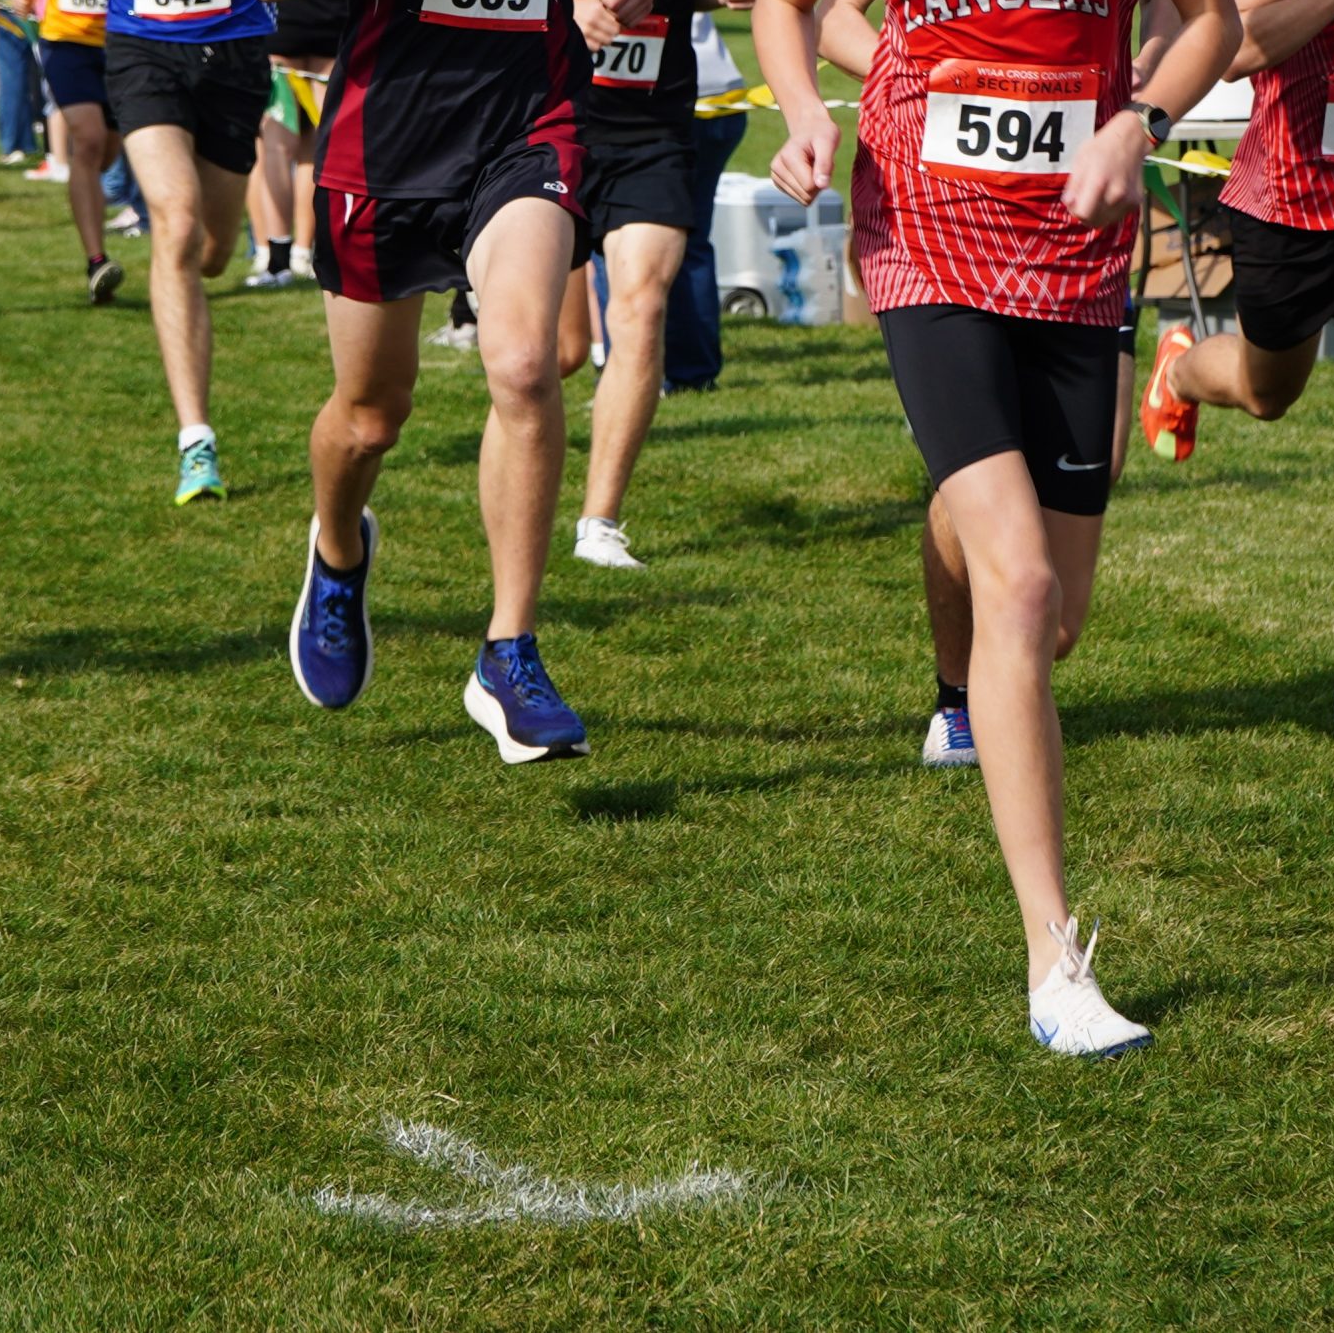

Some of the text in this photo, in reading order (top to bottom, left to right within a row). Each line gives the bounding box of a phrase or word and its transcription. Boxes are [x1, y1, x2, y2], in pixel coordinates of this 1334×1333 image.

[976, 66, 1084, 81] WIAA CROSS COUNTRY
[975, 77, 1084, 95] SECTIONALS
[956, 103, 1065, 163] 594
